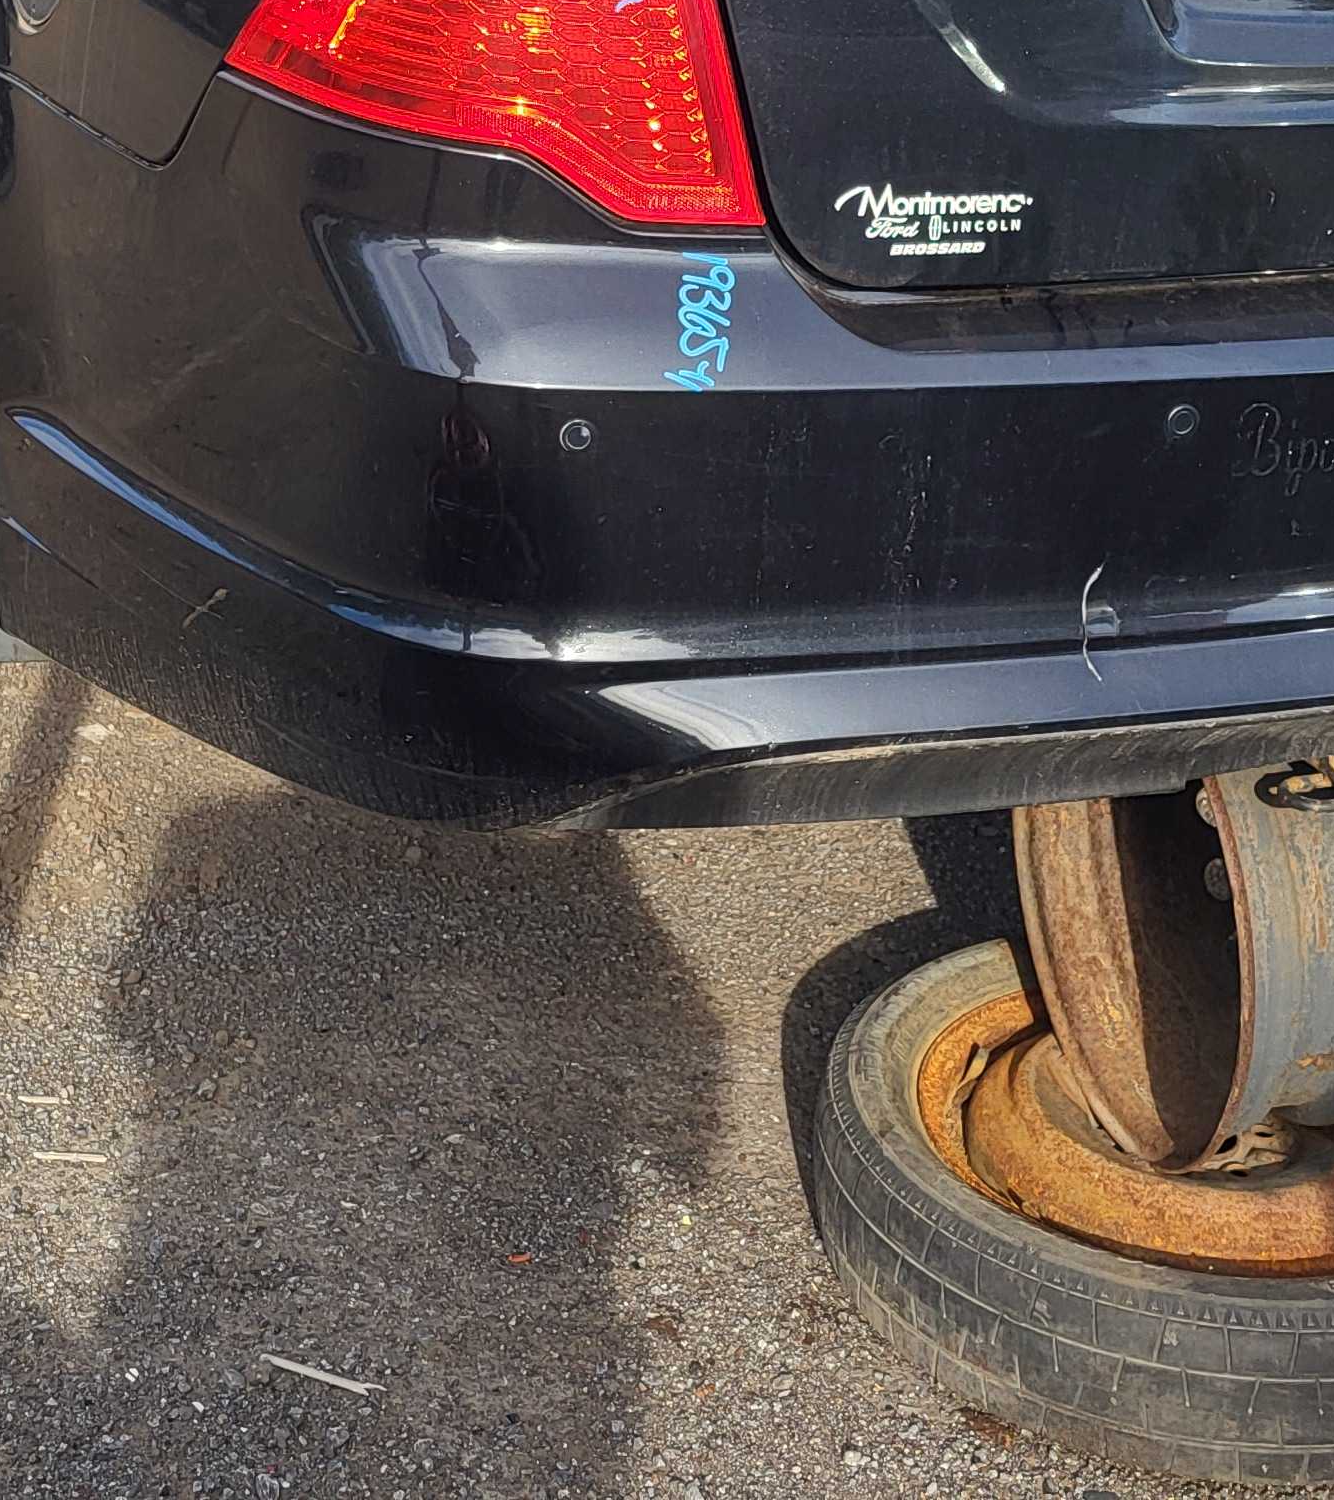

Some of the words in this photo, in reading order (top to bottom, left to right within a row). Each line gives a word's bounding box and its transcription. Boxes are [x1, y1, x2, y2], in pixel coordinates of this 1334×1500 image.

[834, 183, 1033, 218] Montmorenc
[865, 217, 920, 239] Ford
[942, 219, 1022, 234] LINCOLN
[890, 241, 986, 256] BROSSARD
